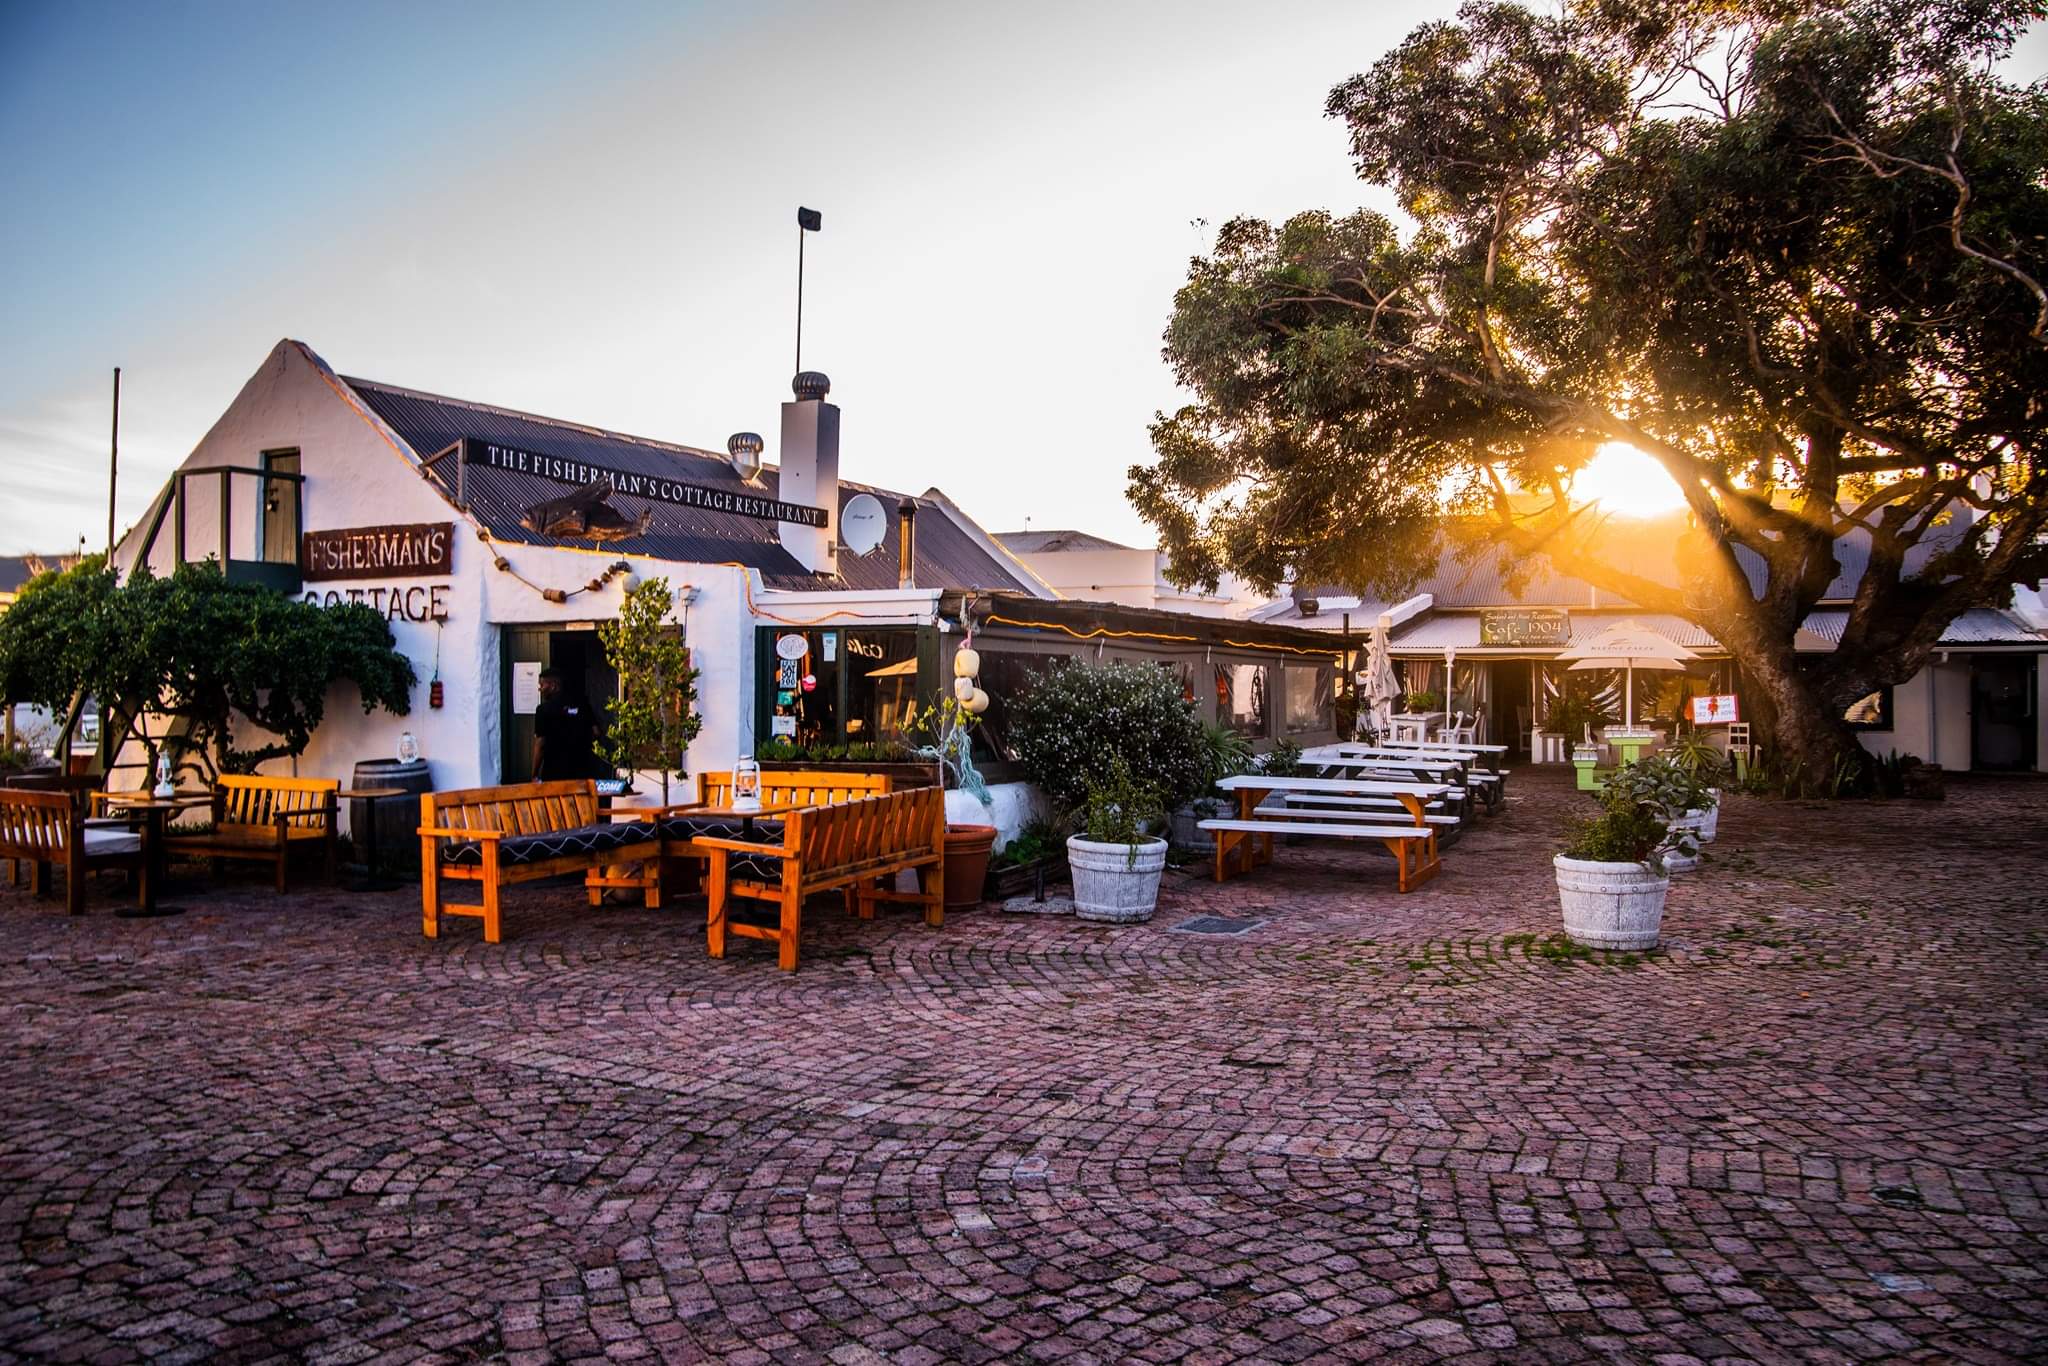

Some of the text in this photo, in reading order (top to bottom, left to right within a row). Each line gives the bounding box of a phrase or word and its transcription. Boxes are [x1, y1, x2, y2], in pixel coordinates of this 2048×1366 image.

[488, 445, 818, 524] THE FISHERMAN'S COTTAGE RESTAURANT
[1528, 622, 1562, 633] 1904
